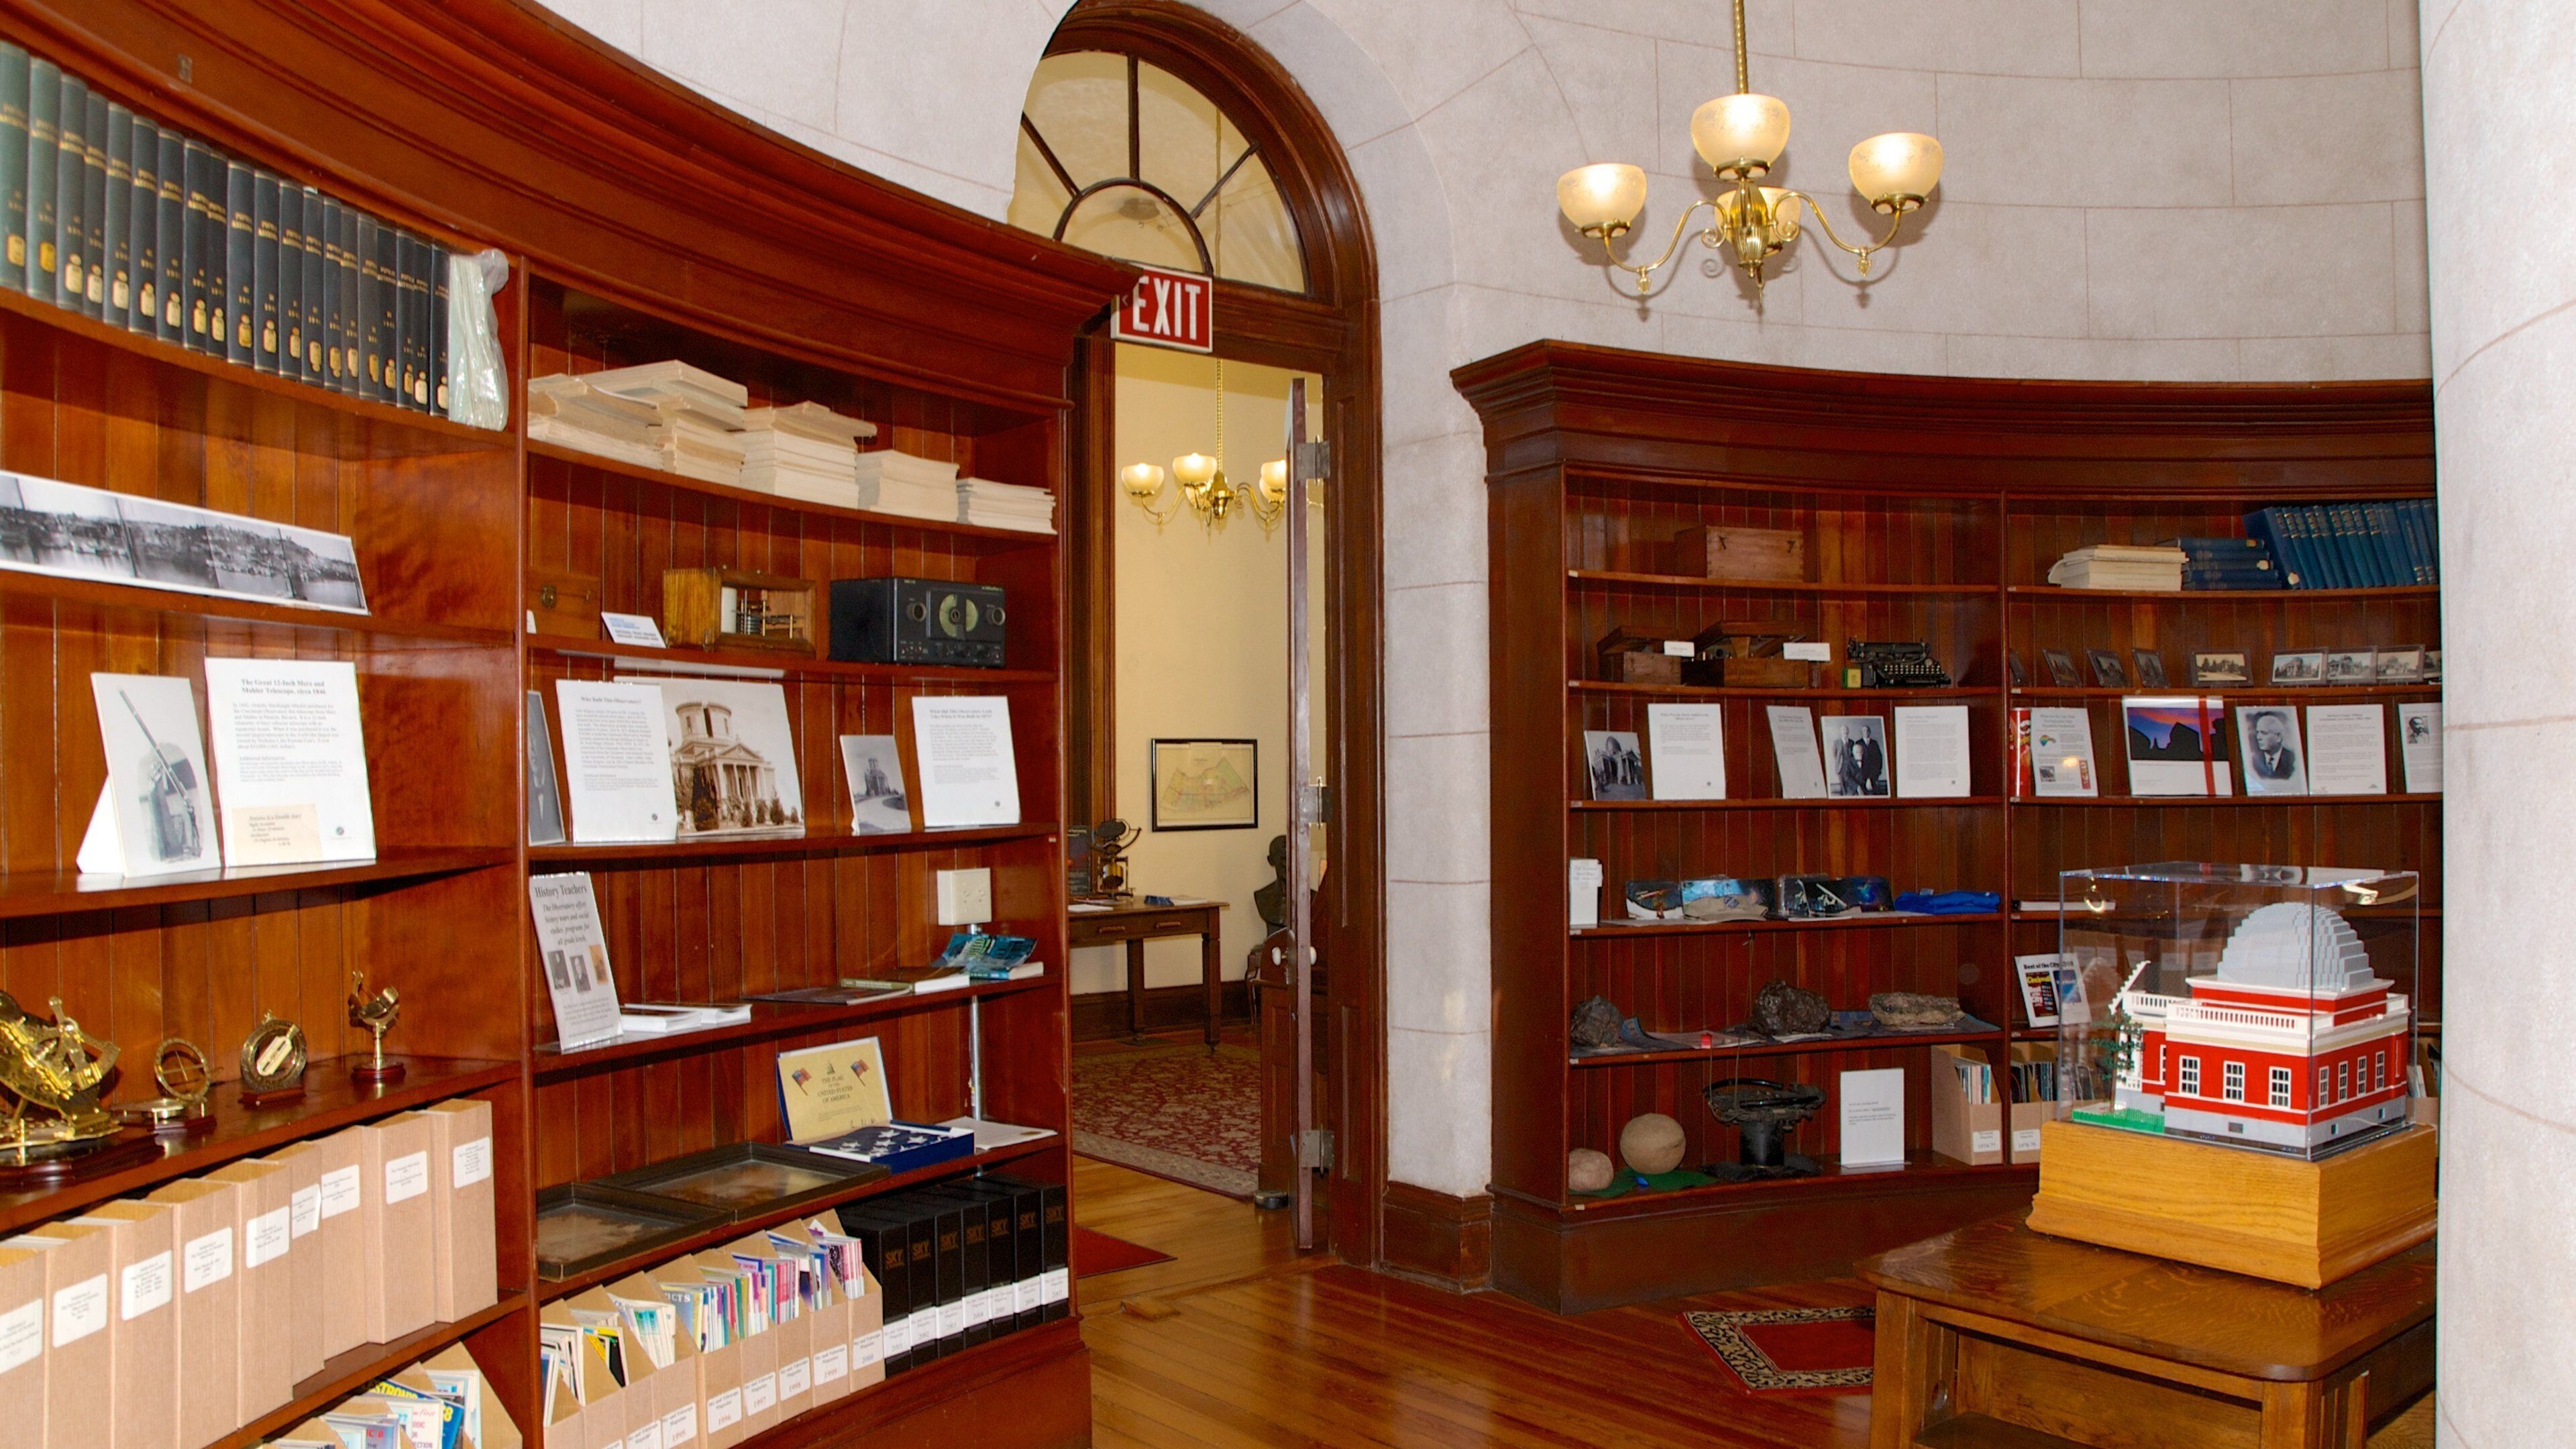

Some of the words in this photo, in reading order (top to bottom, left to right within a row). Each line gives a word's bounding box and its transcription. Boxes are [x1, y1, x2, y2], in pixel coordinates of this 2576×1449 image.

[1133, 276, 1201, 340] EXIT
[535, 886, 559, 898] History
[560, 884, 587, 896] Teachers
[1020, 1212, 1036, 1226] SKY
[1046, 1205, 1063, 1220] SKY
[967, 1224, 984, 1240] SKY
[991, 1218, 1008, 1233] SKY
[941, 1231, 958, 1247] SKY
[912, 1240, 929, 1256] SKY
[885, 1249, 902, 1265] SKY
